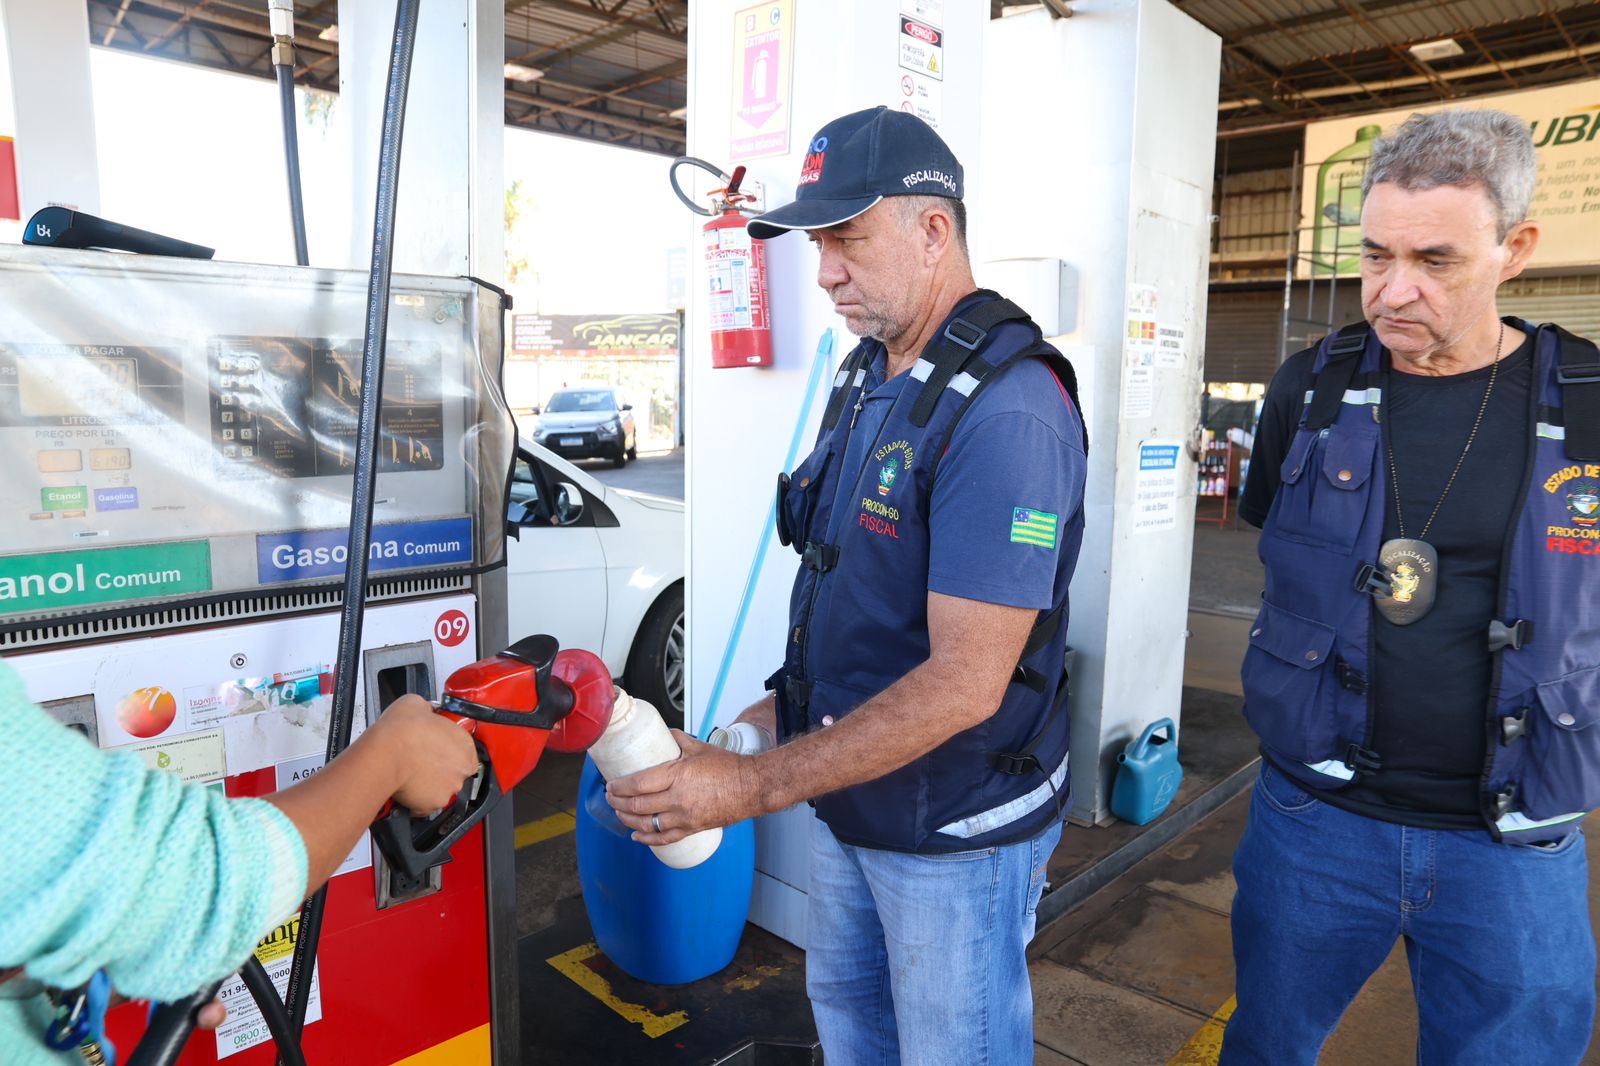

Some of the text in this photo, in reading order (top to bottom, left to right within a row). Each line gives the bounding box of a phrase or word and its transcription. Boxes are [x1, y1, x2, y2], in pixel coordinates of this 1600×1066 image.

[903, 170, 957, 192] FISCALIZAÇÃO
[369, 301, 377, 335] INMETRO
[588, 333, 677, 346] JANCAR
[84, 347, 124, 356] PAGAR
[365, 338, 374, 377] PORTARIA
[35, 430, 73, 439] PREÇO
[76, 430, 98, 438] POR
[1543, 465, 1582, 494] ESTADO
[49, 492, 81, 501] Etanol
[98, 493, 134, 503] Gasolina
[862, 497, 899, 520] PROCON-GO
[859, 512, 900, 538] FISCAL
[271, 537, 461, 569] Gasona Comum
[95, 566, 181, 591] Comum
[437, 617, 467, 640] 09
[292, 772, 300, 781] A
[234, 1028, 259, 1045] 0800
